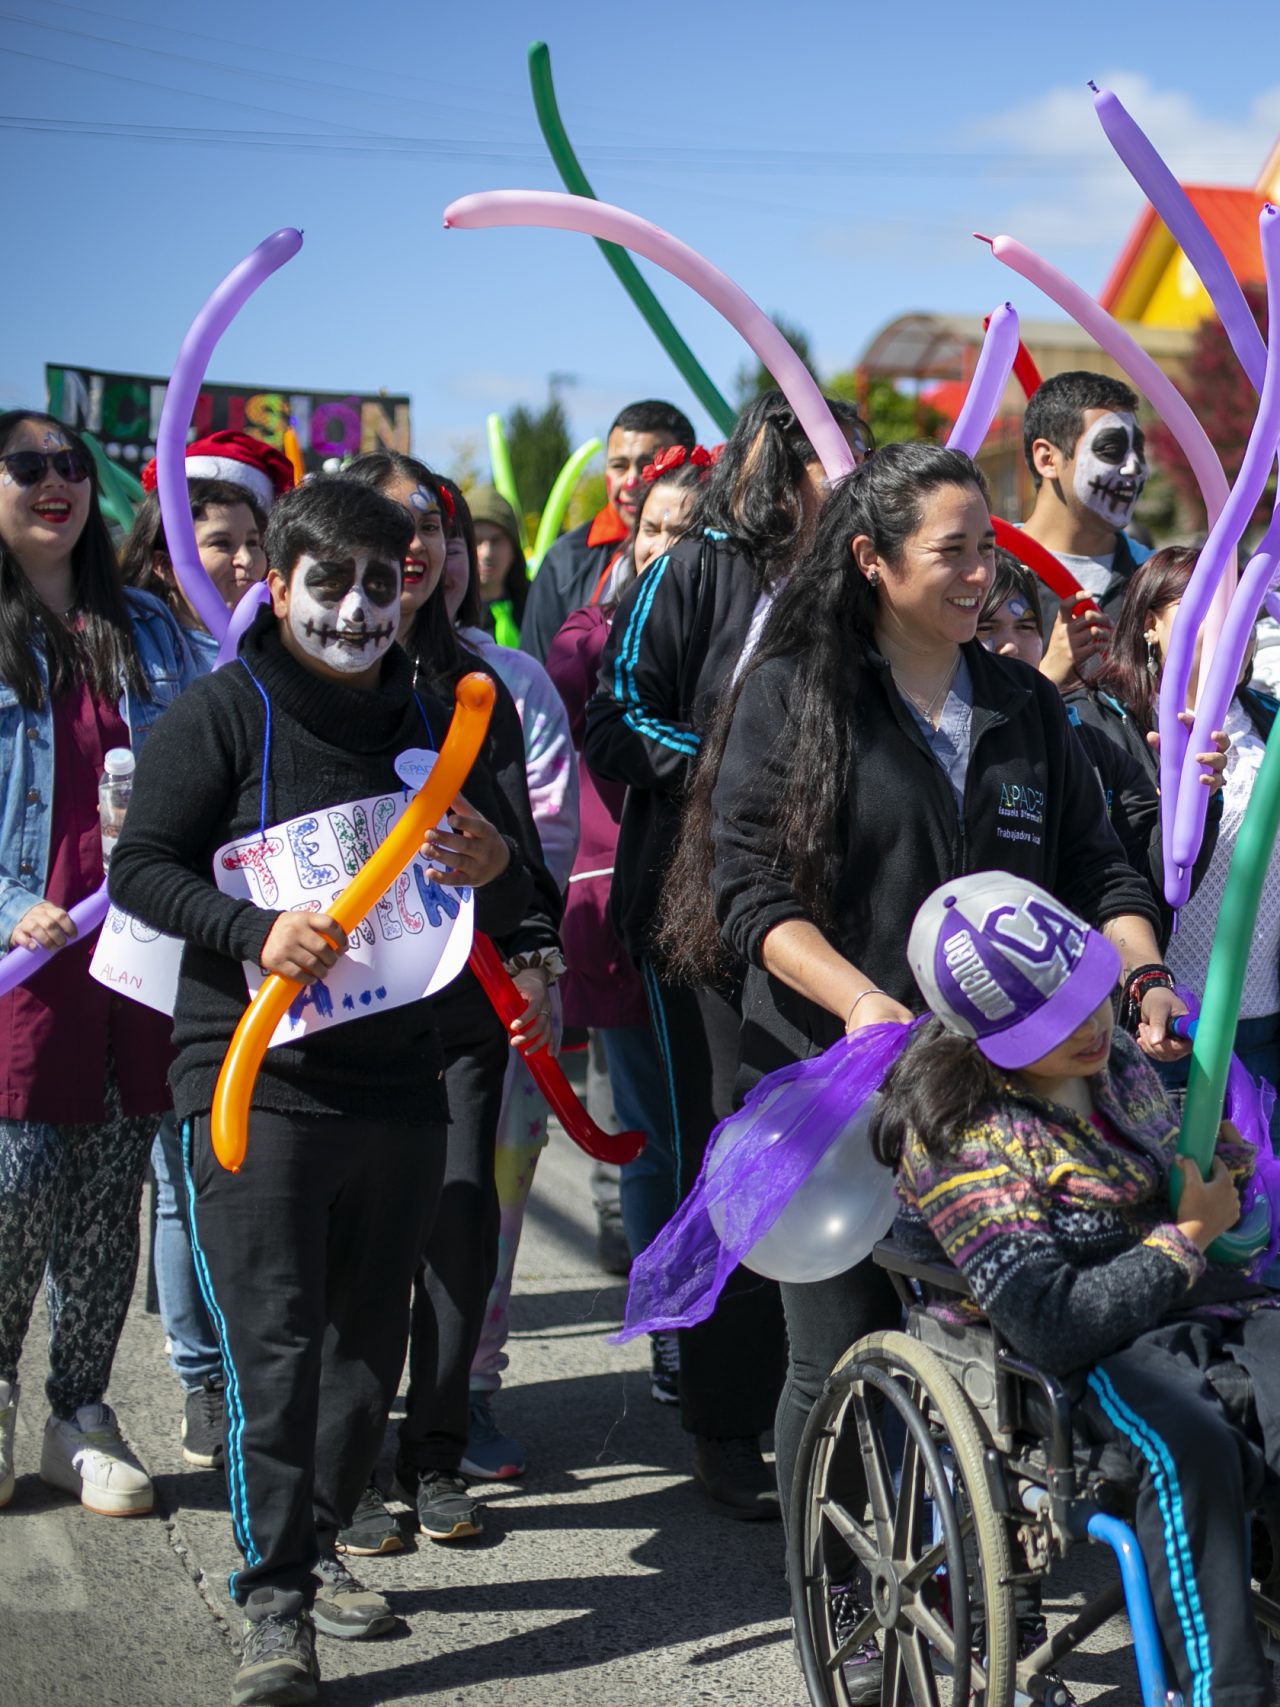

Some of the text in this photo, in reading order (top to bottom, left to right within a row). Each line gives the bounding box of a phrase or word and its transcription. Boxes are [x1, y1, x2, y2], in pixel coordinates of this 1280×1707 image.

[221, 797, 437, 907] TEN
[101, 963, 142, 989] ALAN
[943, 929, 1016, 1021] CHICAGO
